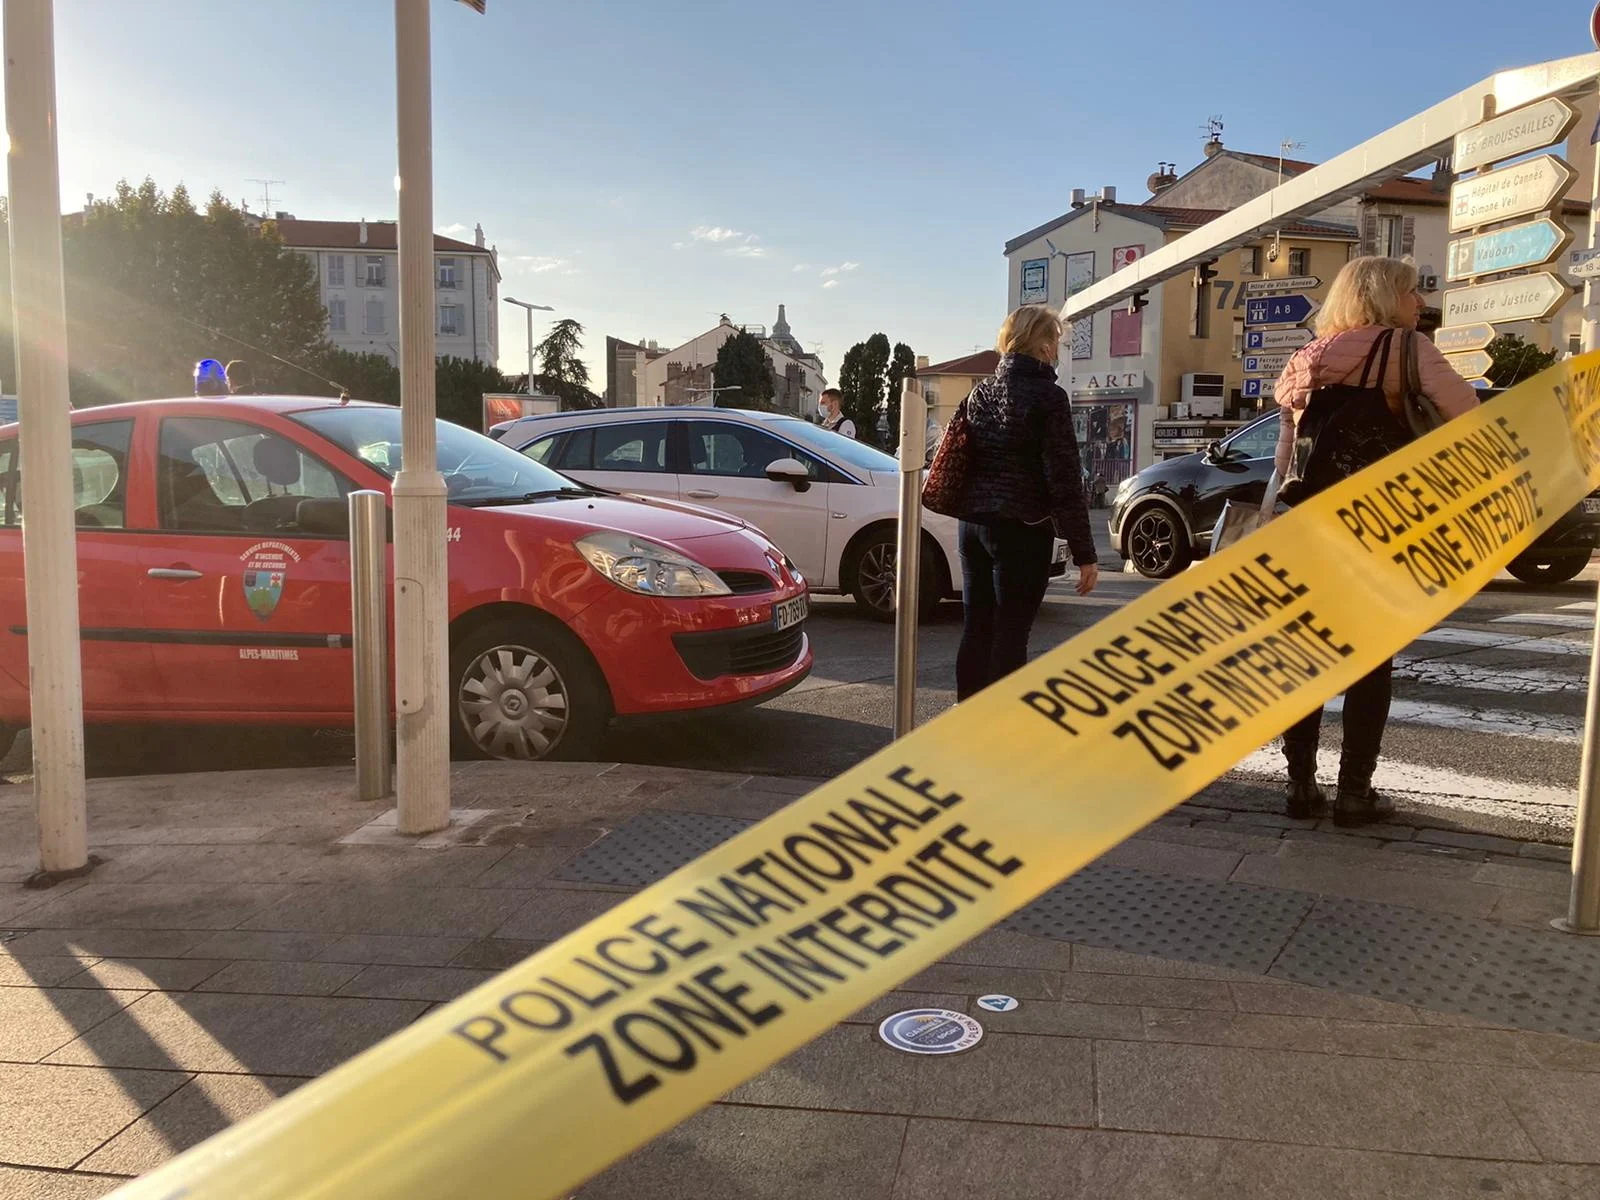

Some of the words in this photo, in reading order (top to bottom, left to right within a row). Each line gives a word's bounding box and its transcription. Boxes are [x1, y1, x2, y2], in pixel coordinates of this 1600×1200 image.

[1460, 140, 1477, 157] LES
[1482, 113, 1556, 149] BROUSSAILLES
[1471, 180, 1501, 199] Hôpital
[1502, 177, 1511, 189] de
[1513, 171, 1544, 187] Cannes
[1470, 202, 1500, 217] Simone
[1502, 194, 1518, 209] Veil
[1476, 243, 1515, 261] Vauban
[1572, 264, 1583, 274] du
[1586, 262, 1594, 272] 18
[1274, 305, 1281, 315] A
[1284, 304, 1291, 314] 8
[1449, 300, 1479, 316] Palais
[1483, 297, 1496, 311] de
[1501, 290, 1541, 308] Justice
[1087, 372, 1137, 389] ART
[1336, 472, 1441, 553] POLICE
[1412, 416, 1532, 505] NATIONALE
[1392, 523, 1476, 597] ZONE
[1453, 470, 1544, 561] INTERDITE
[239, 648, 299, 661] ALPES-MARITIMES
[1020, 634, 1174, 737] POLICE
[1135, 552, 1311, 661] NATIONALE
[1112, 682, 1241, 771] ZONE
[1196, 610, 1355, 718] INTERDITE
[450, 913, 713, 1063] POLICE
[694, 765, 965, 937] NATIONALE
[563, 964, 787, 1107] ZONE
[739, 823, 1026, 1001] INTERDITE
